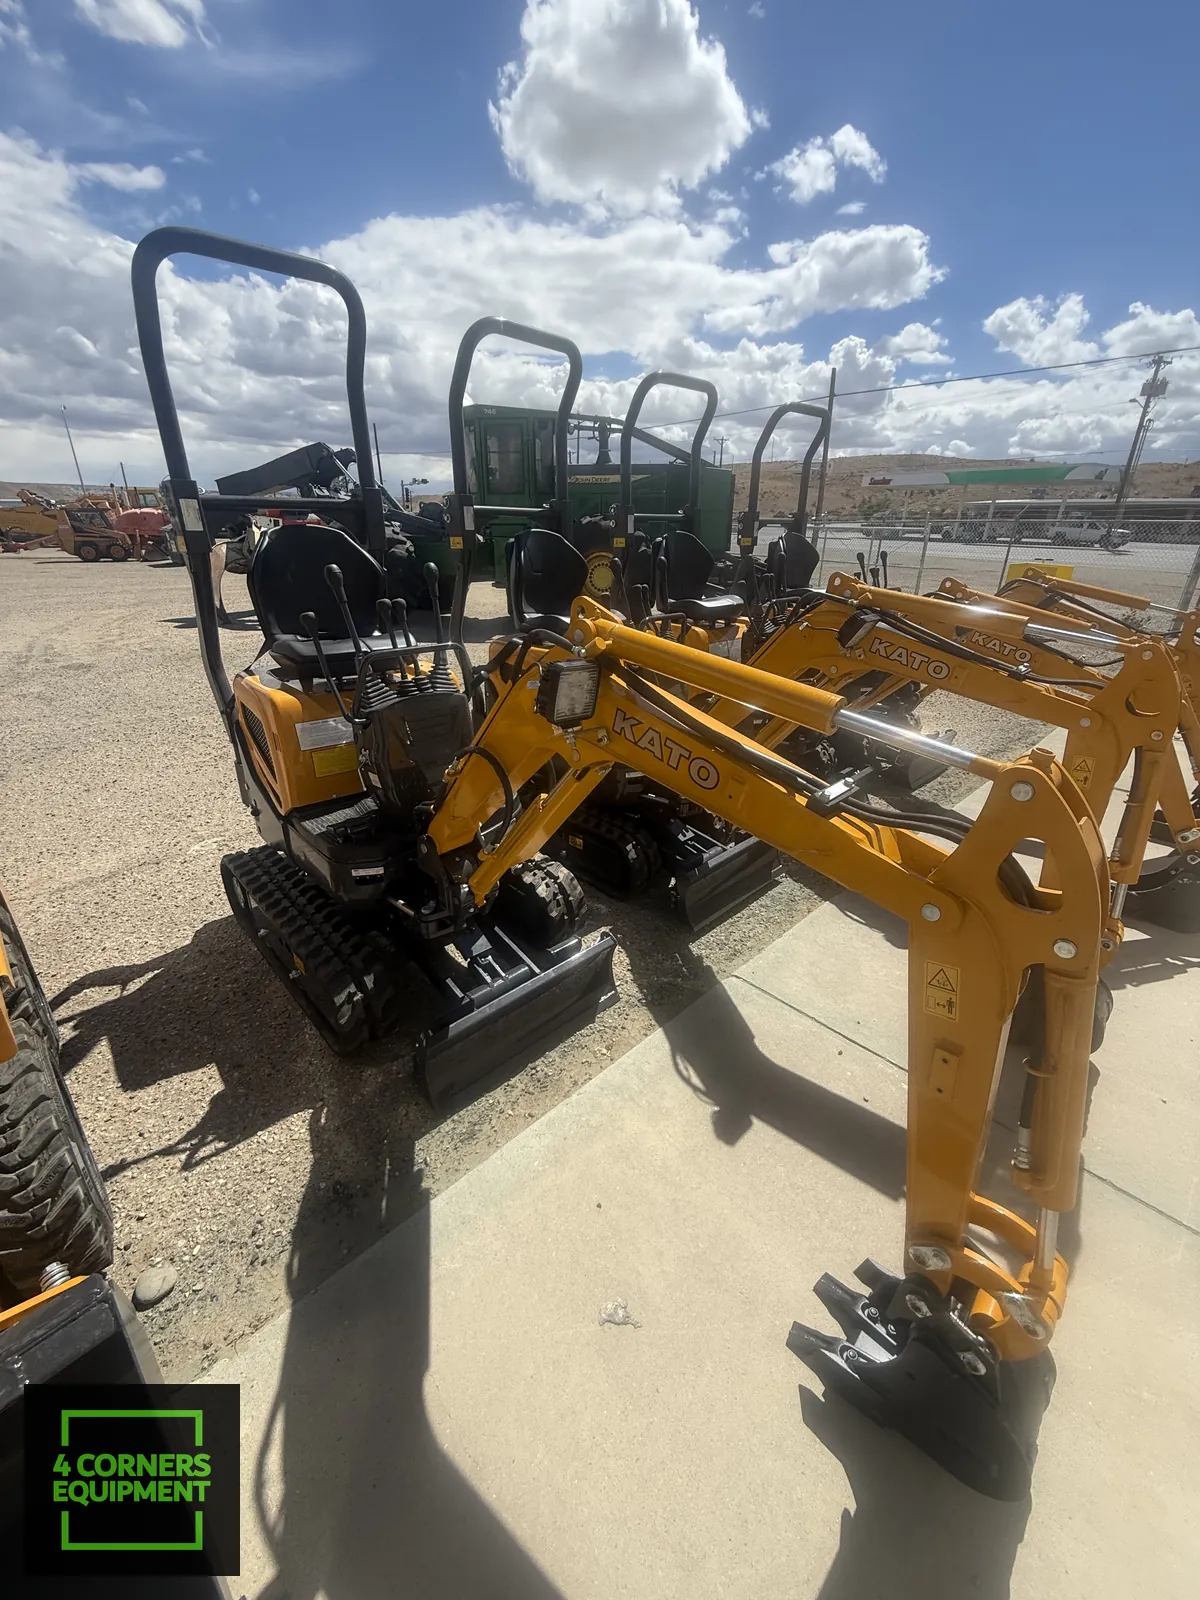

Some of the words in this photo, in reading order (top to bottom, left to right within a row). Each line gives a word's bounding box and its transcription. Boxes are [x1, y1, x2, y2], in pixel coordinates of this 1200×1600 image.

[870, 636, 950, 680] KATO
[970, 630, 1033, 663] KATO
[612, 706, 720, 790] KATO
